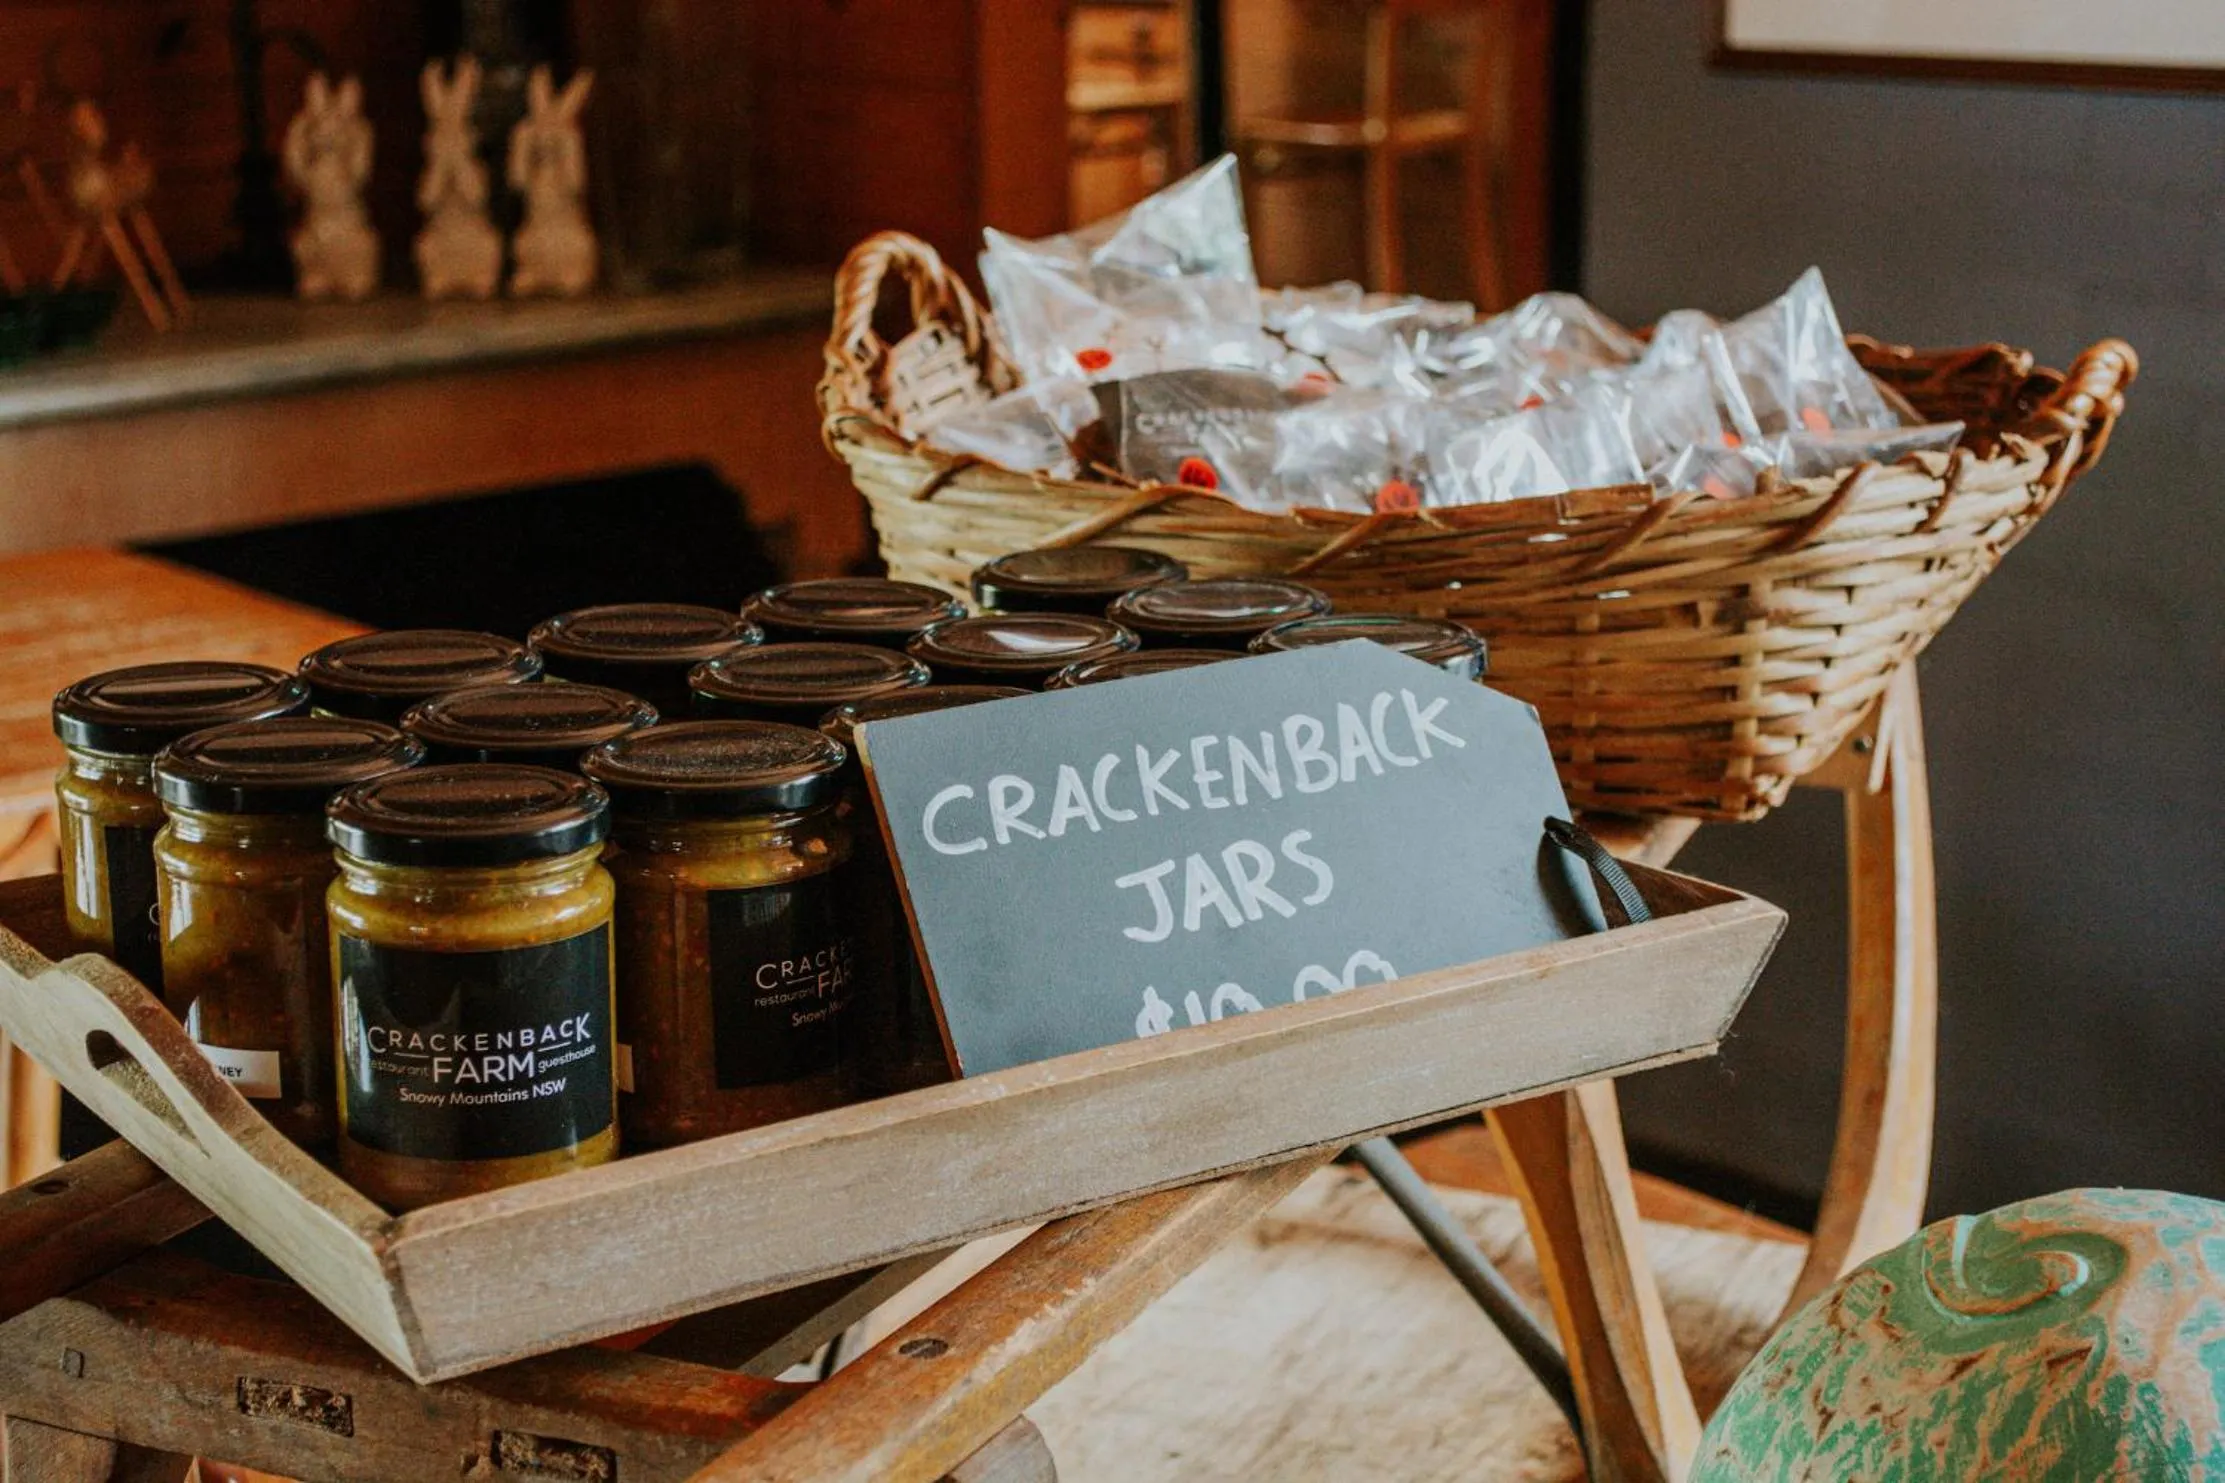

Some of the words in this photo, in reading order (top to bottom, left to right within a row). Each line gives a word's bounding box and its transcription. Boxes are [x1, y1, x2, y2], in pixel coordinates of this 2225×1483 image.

[922, 688, 1467, 855] CRACKENBACK
[1114, 829, 1335, 943] JARS
[367, 1011, 592, 1054] CRACKENBACK
[432, 1050, 536, 1084] FARM
[537, 1044, 597, 1074] guesthouse
[399, 1087, 446, 1109] Snowy
[449, 1089, 530, 1106] Mountains
[532, 1077, 568, 1098] NSW
